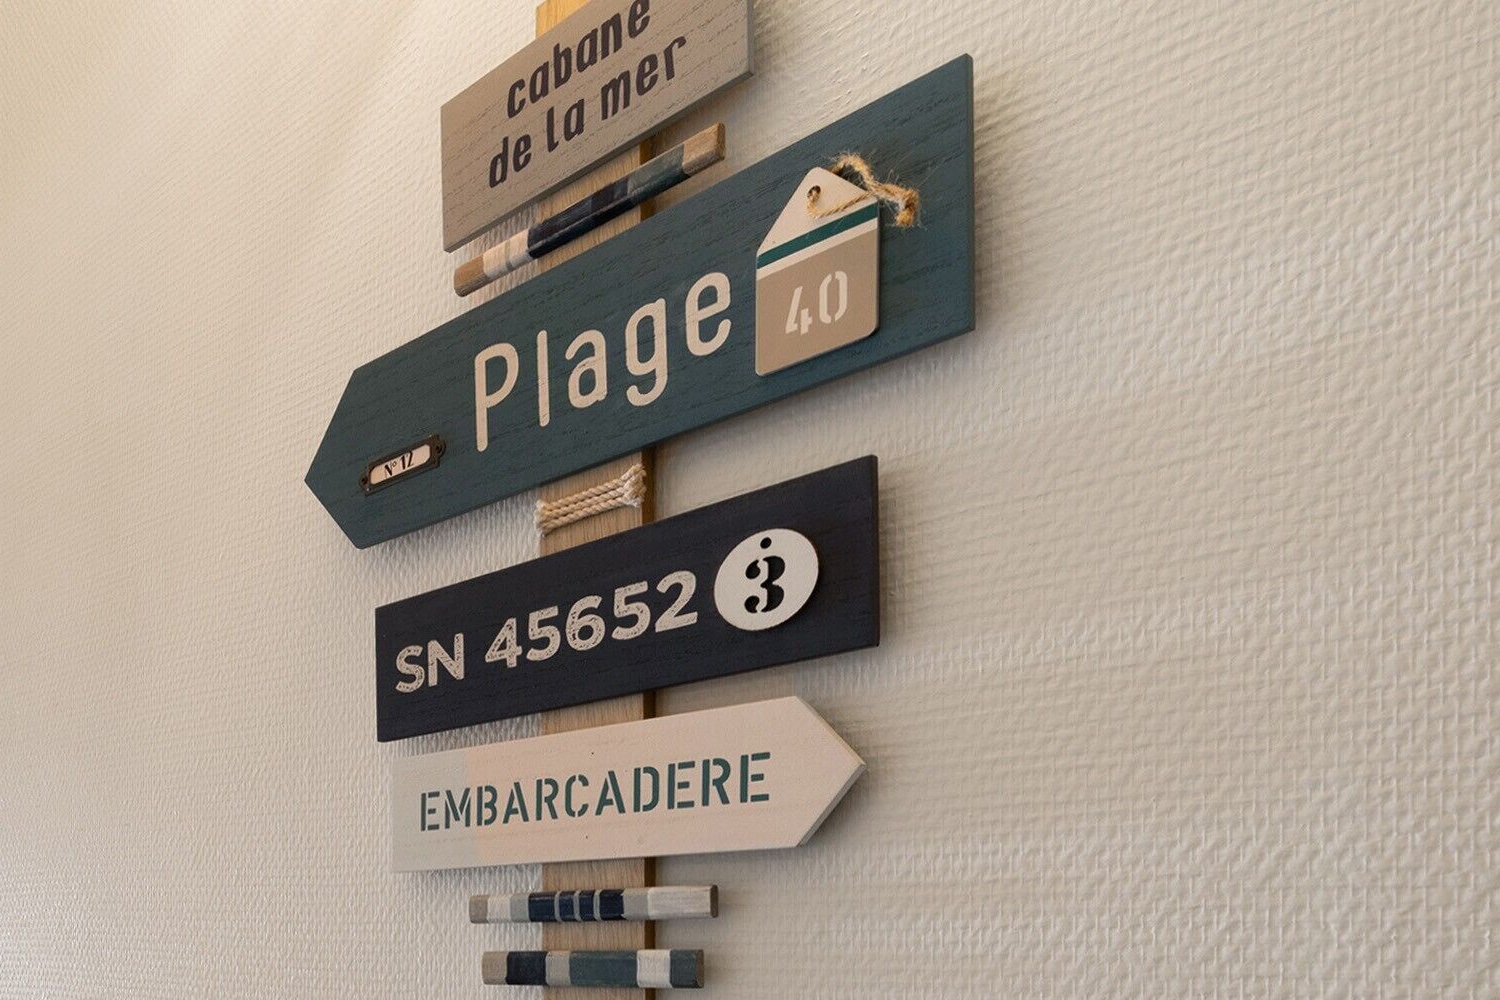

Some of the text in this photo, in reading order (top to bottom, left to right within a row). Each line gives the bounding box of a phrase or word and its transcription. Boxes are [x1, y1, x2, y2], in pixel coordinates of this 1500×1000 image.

[507, 0, 650, 118] cabane
[488, 36, 687, 188] de la mer
[784, 270, 849, 336] 40
[474, 272, 732, 452] Plage
[400, 451, 414, 470] 12
[395, 570, 699, 693] SN 45652
[743, 554, 786, 614] 3
[420, 751, 771, 831] EMBARCADERE
